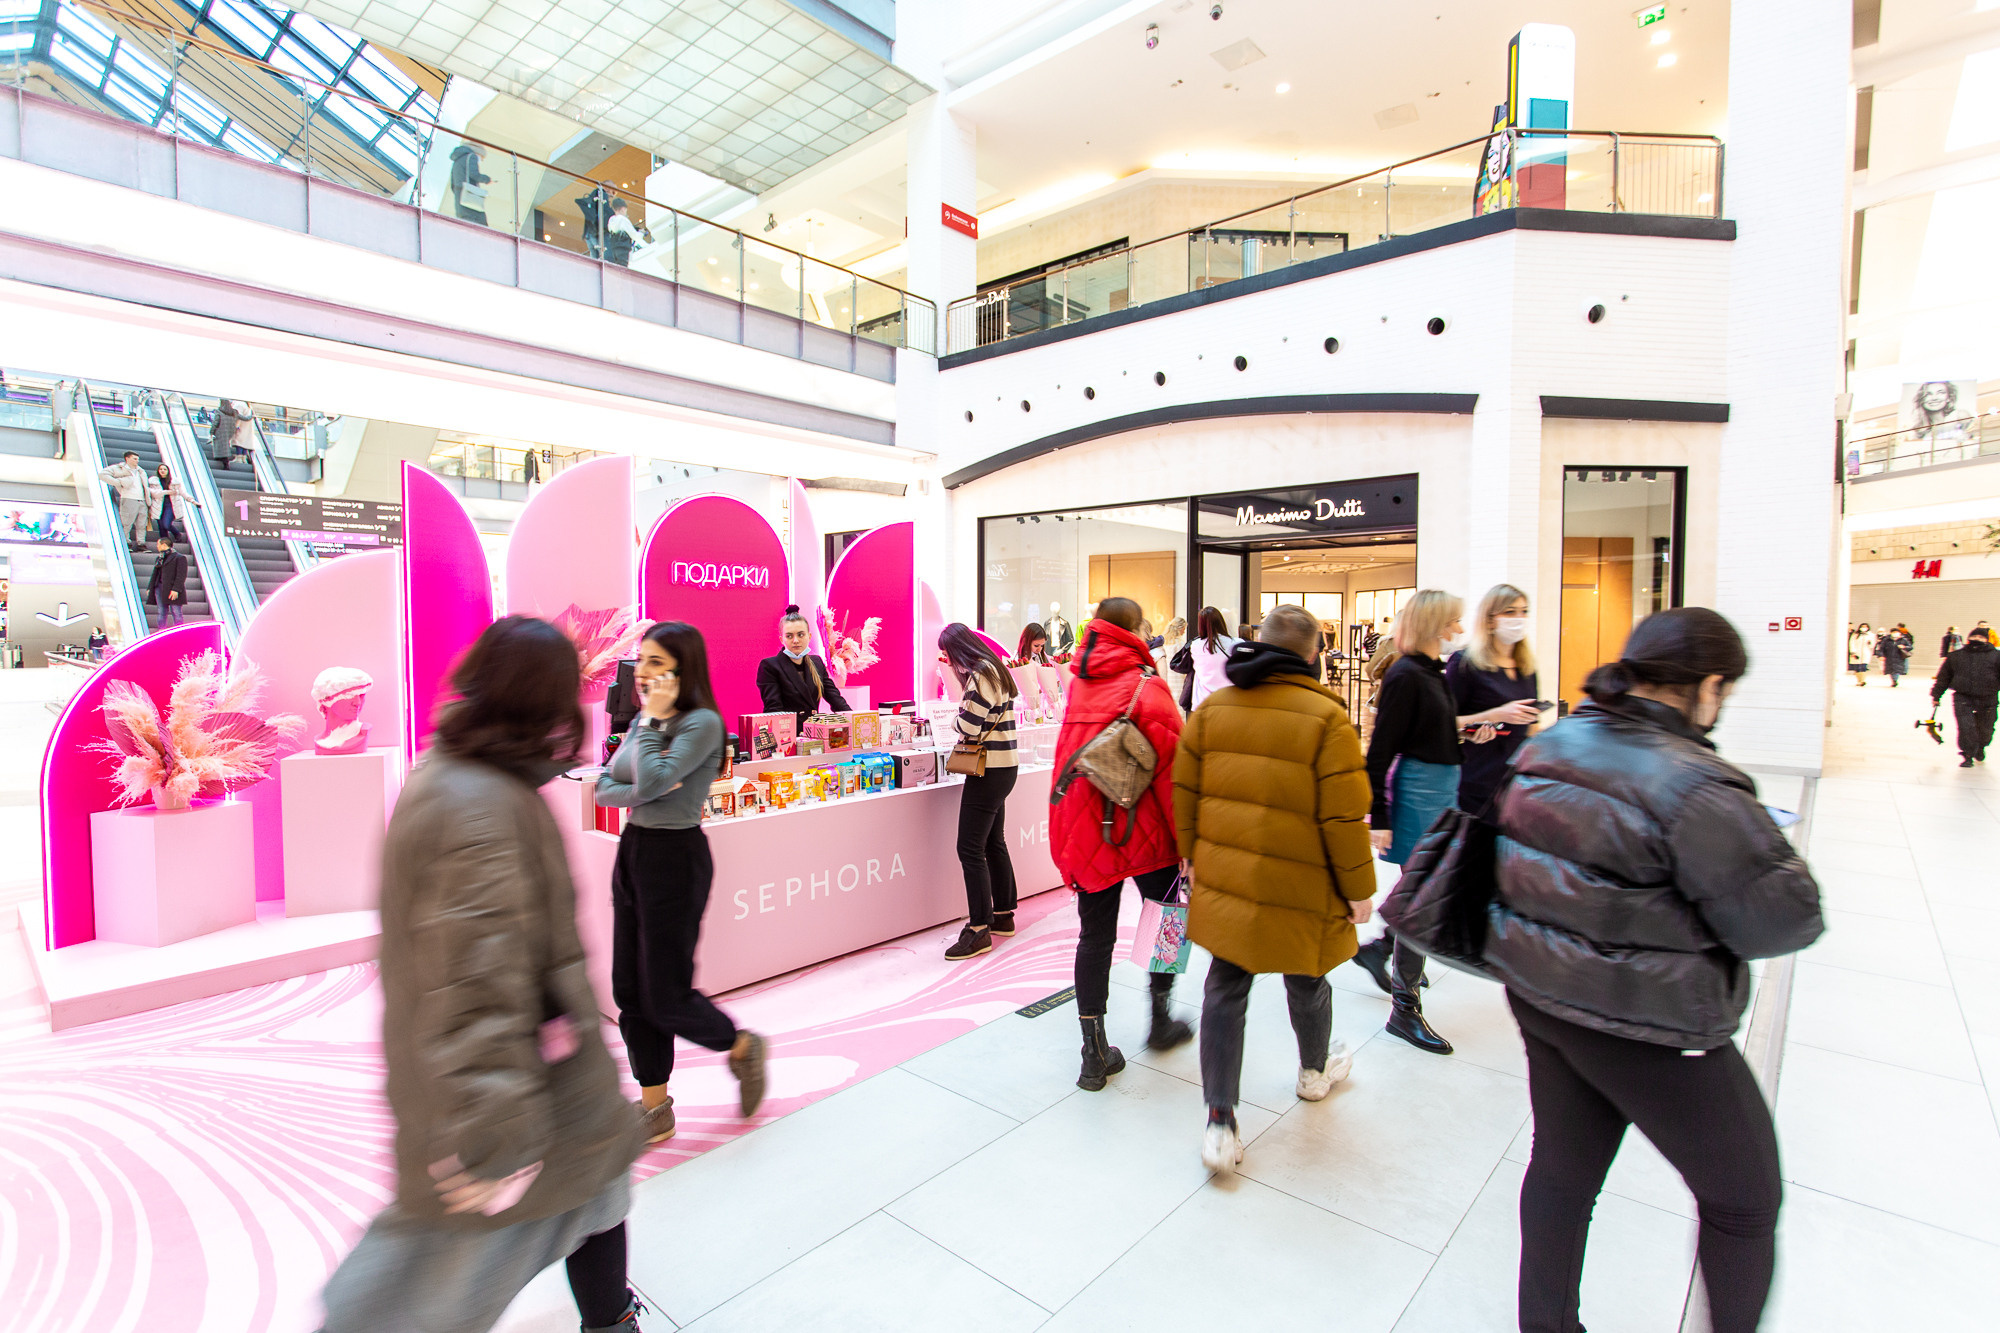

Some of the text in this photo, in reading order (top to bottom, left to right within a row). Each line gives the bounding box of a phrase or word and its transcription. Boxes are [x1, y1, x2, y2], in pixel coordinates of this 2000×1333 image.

[234, 499, 249, 521] 1
[1235, 499, 1366, 526] Massimo Dutti
[673, 561, 769, 588] ПОДАРКИ
[1912, 559, 1942, 579] H&M
[733, 852, 906, 921] SEPHORA
